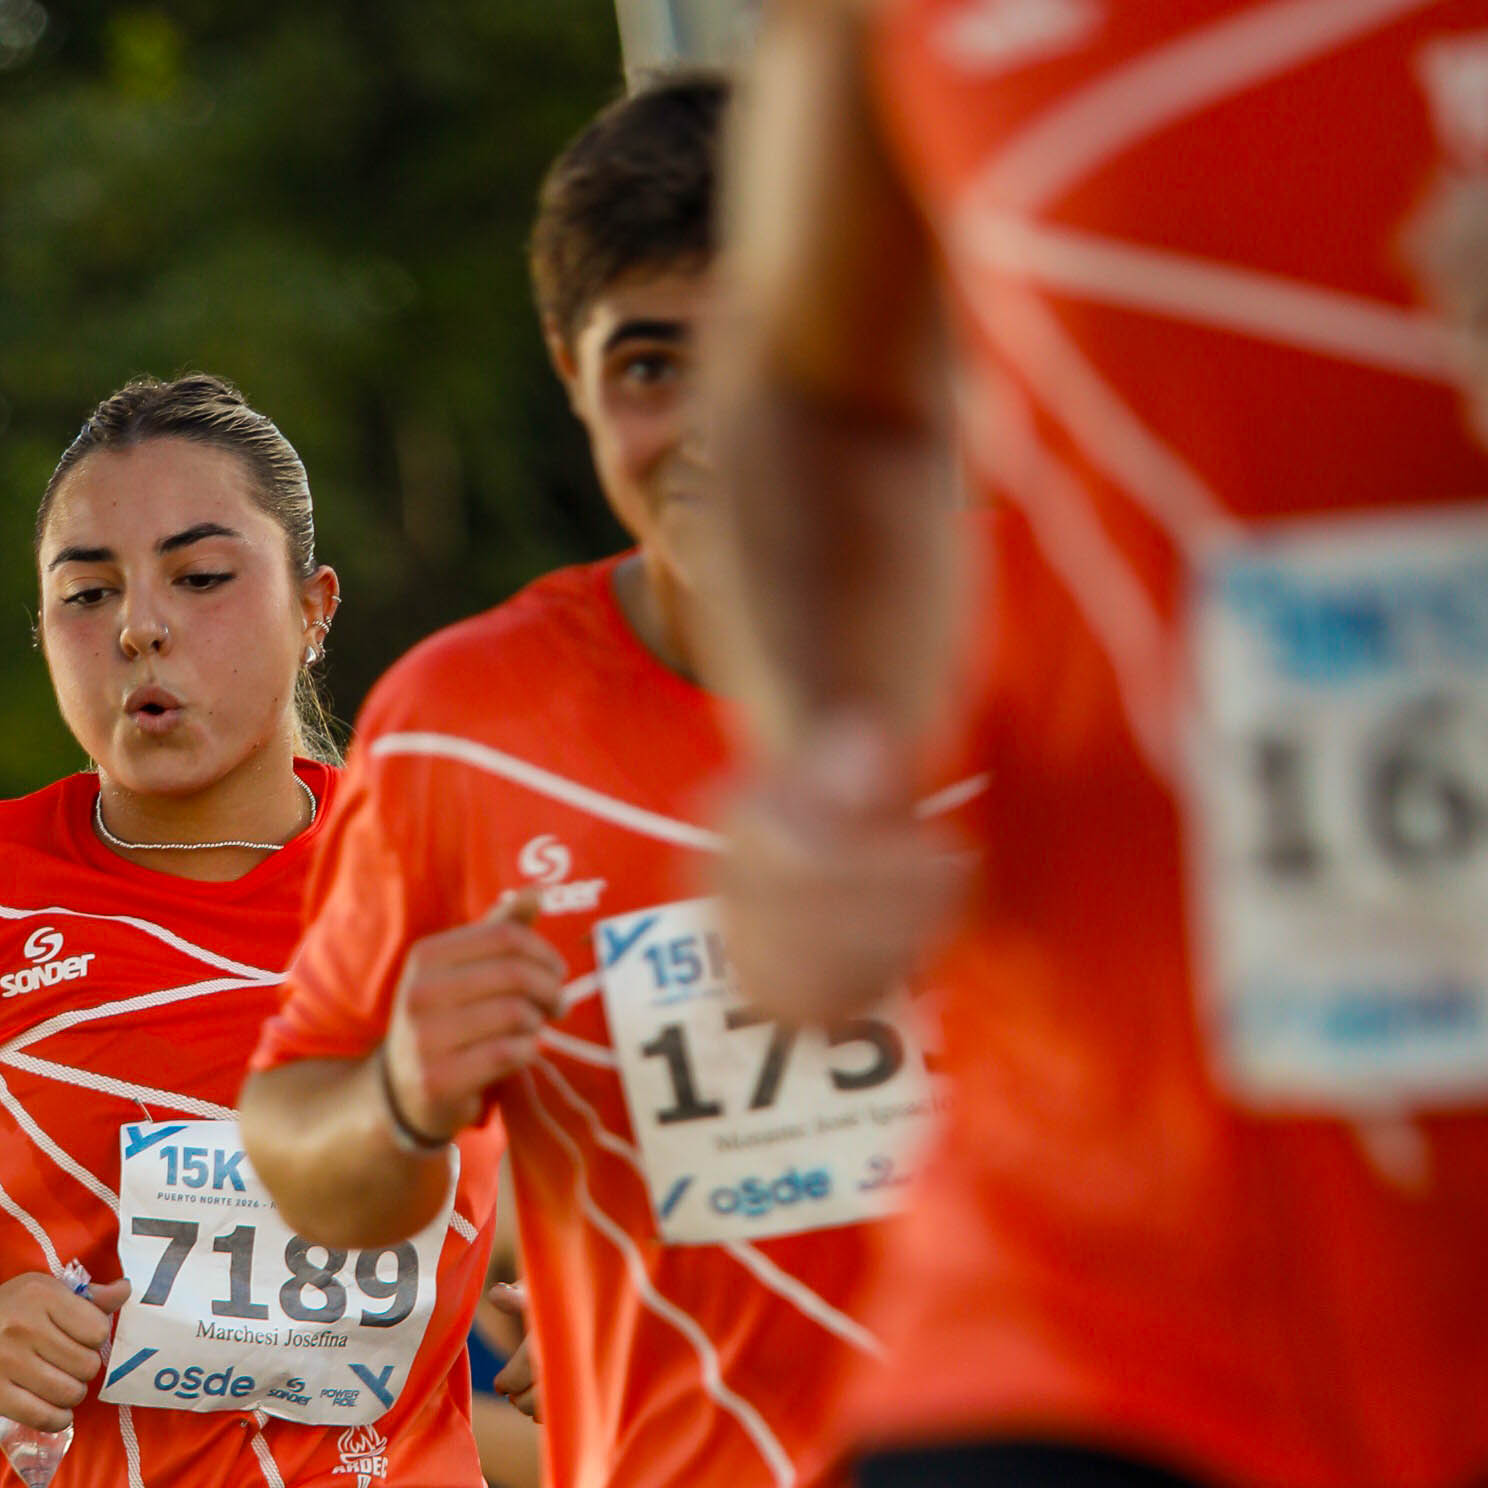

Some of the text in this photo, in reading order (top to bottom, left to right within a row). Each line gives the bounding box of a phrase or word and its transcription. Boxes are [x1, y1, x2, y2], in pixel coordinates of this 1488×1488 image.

[160, 1145, 247, 1192] 15K
[131, 1216, 419, 1328] 7189
[195, 1319, 349, 1348] Marchesi Josefina
